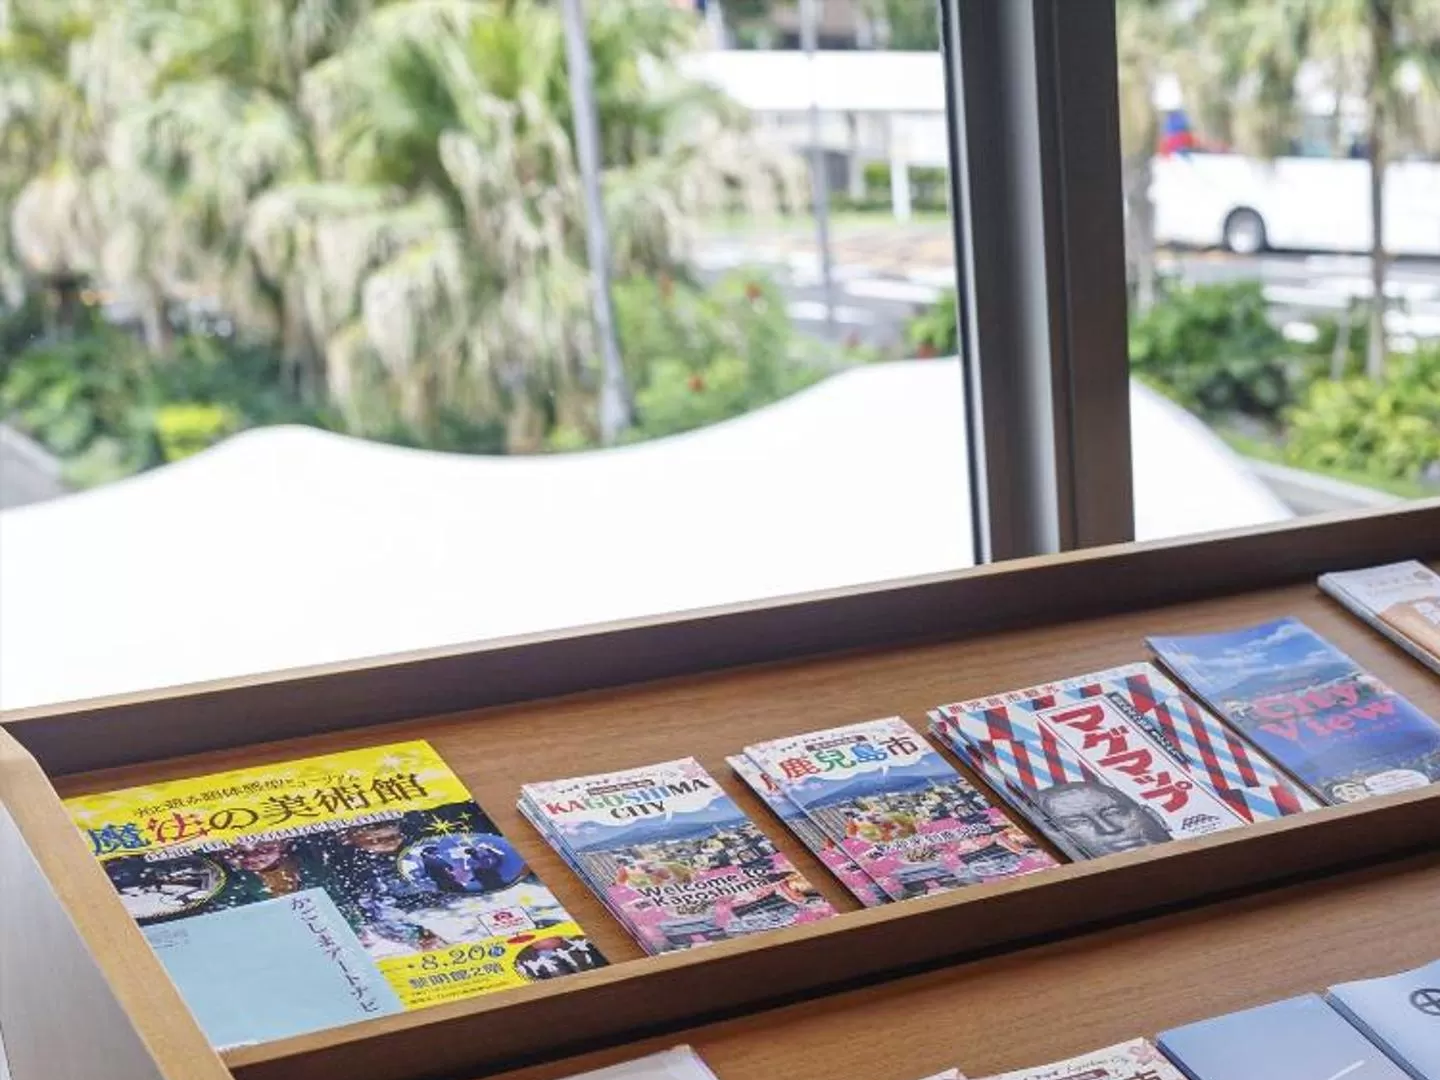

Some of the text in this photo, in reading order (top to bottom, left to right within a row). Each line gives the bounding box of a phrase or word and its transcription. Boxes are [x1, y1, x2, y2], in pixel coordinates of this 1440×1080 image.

[777, 734, 919, 778] 鹿兒島市
[1051, 705, 1196, 814] マグマップ
[87, 772, 428, 857] 魔法の美術館
[544, 776, 711, 818] KAGOSHIMA
[609, 800, 668, 821] CITY
[636, 870, 745, 901] Welcome
[650, 876, 770, 910] Kagoshima
